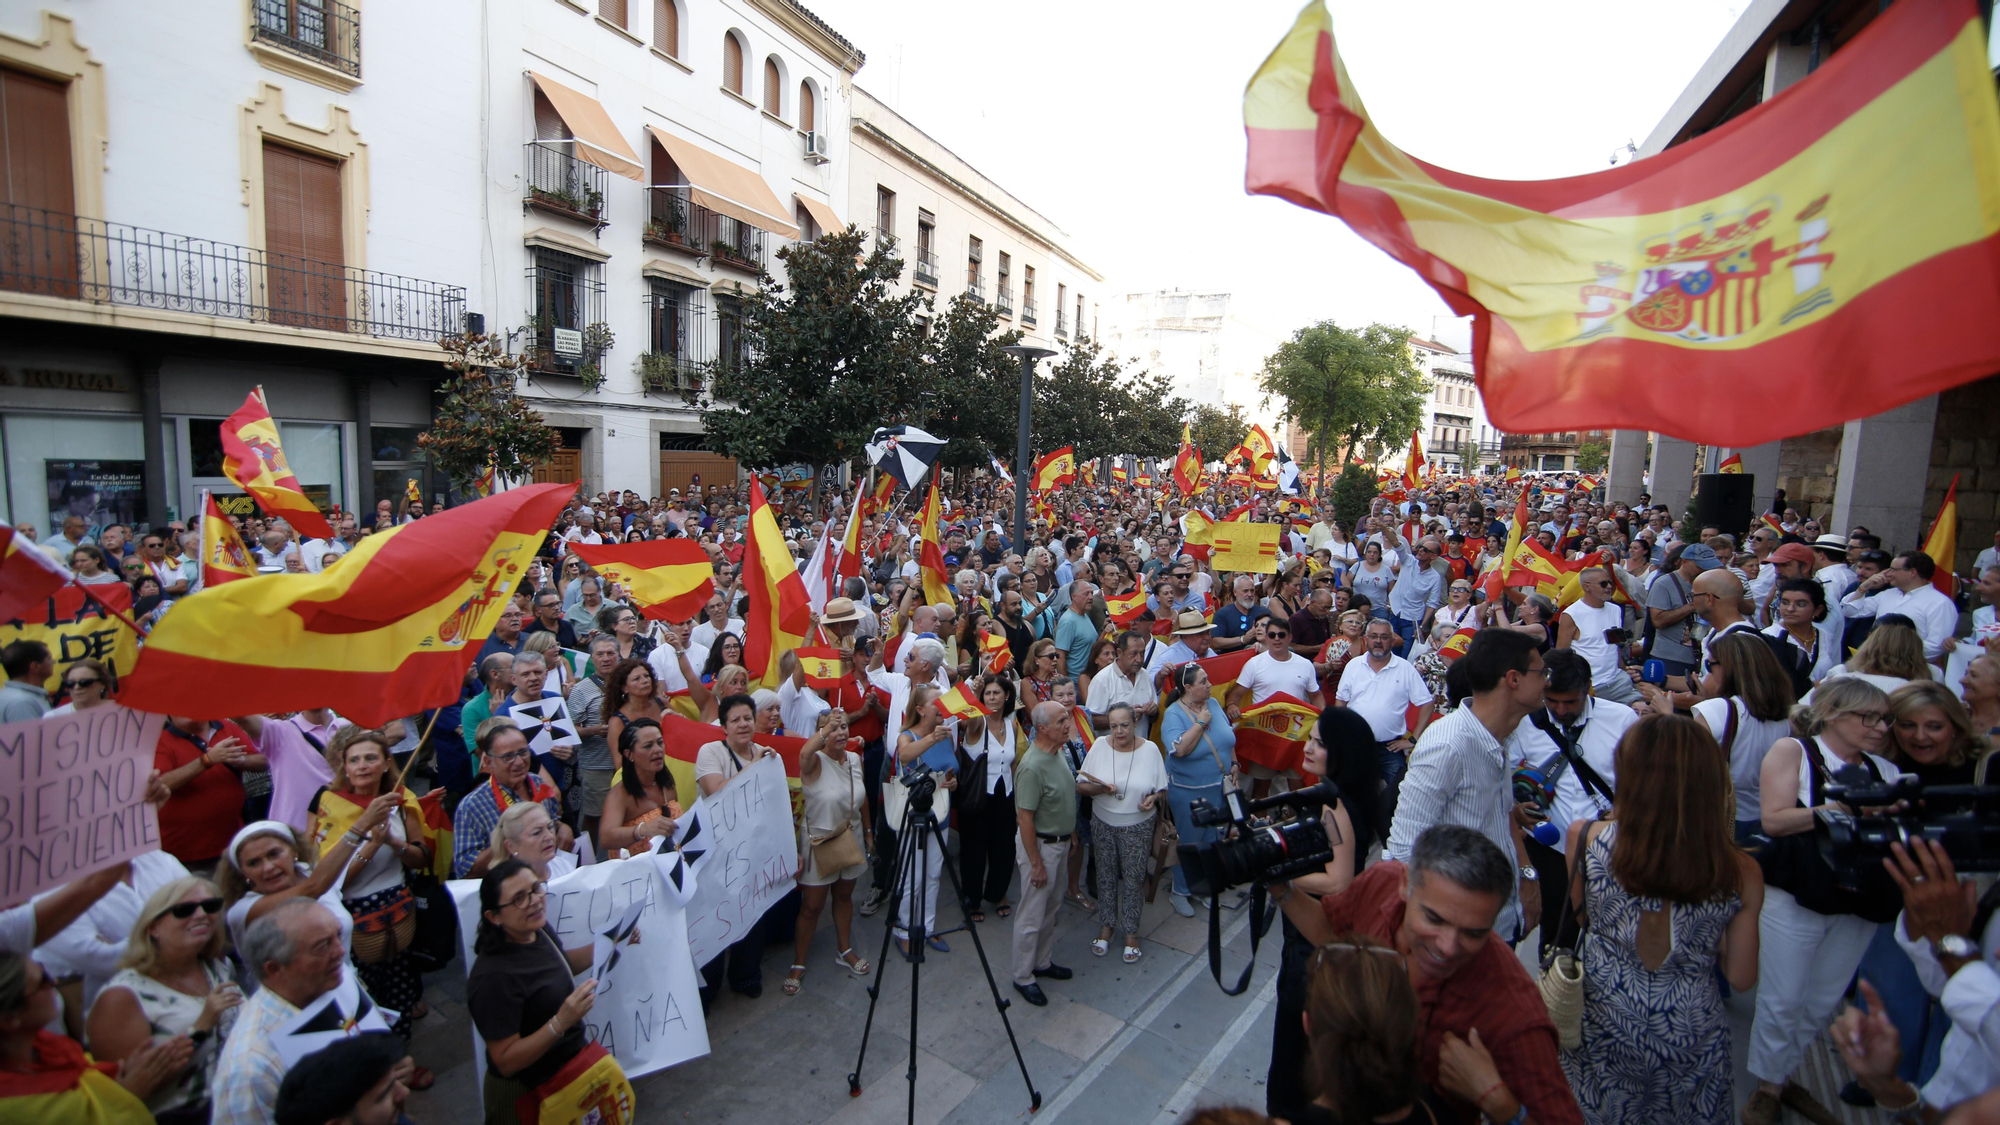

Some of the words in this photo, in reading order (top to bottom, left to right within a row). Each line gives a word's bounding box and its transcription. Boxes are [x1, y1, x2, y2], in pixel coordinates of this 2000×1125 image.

[23, 368, 129, 392] RURAL
[102, 474, 119, 482] Caja
[1220, 523, 1272, 541] CEUTA
[1234, 541, 1253, 554] ES
[1469, 550, 1475, 559] 7
[58, 627, 119, 663] DE
[708, 773, 766, 844] EUTA
[725, 840, 751, 888] ES
[545, 872, 656, 935] EUTA
[687, 854, 790, 958] ESPAÑA
[584, 991, 688, 1057] PAÑA
